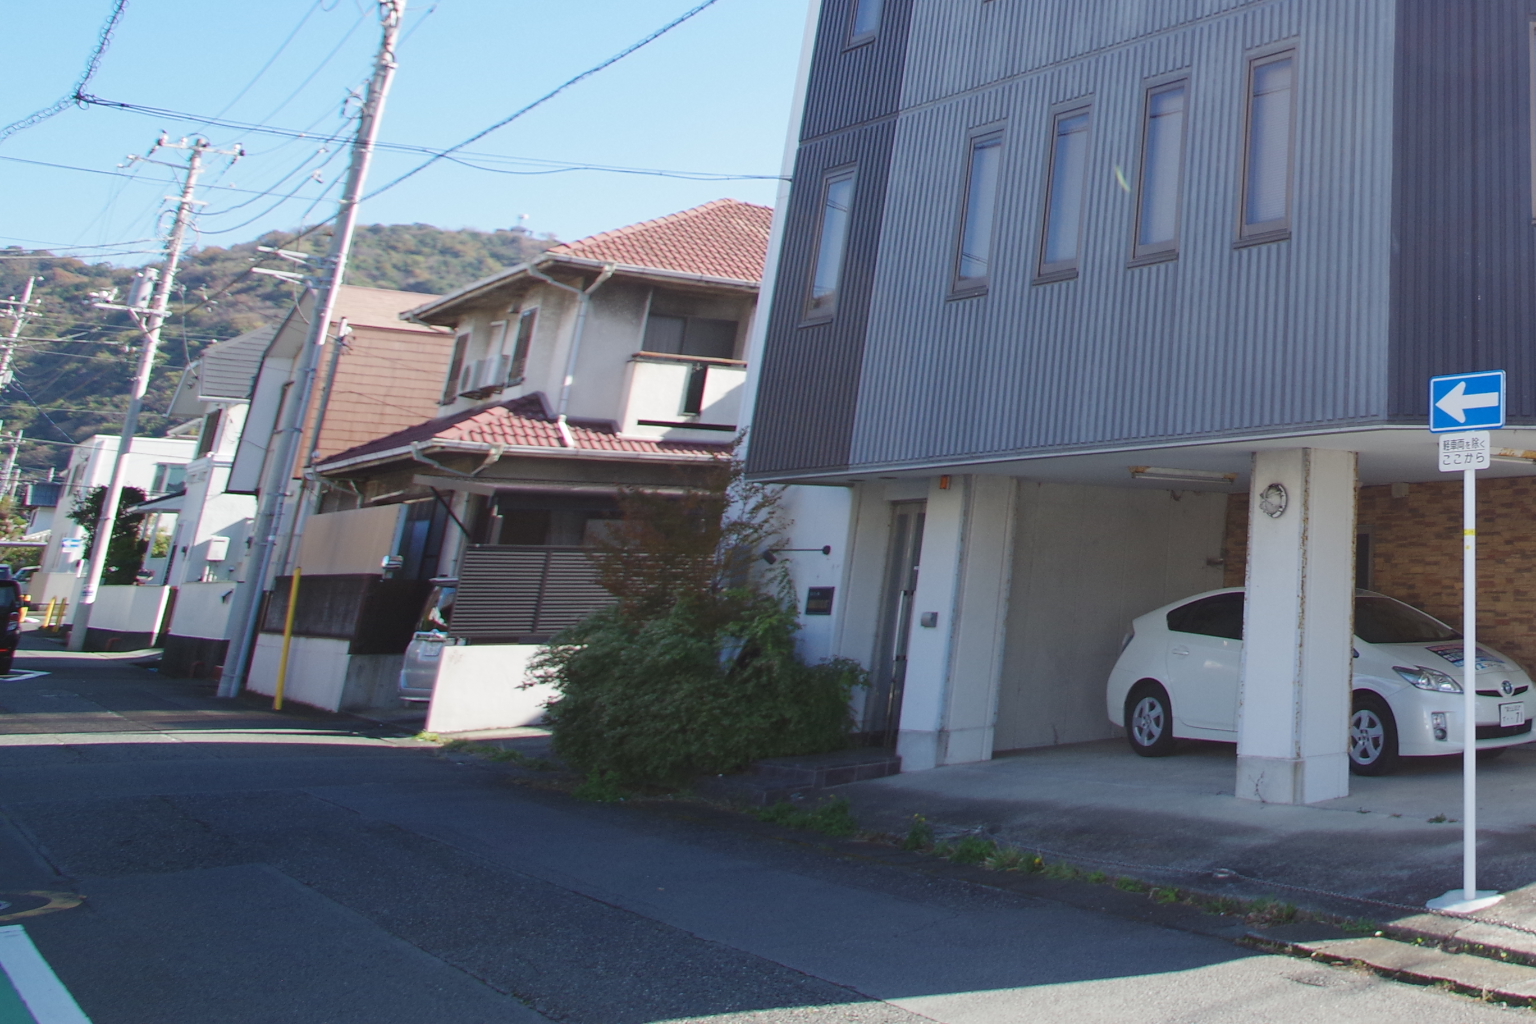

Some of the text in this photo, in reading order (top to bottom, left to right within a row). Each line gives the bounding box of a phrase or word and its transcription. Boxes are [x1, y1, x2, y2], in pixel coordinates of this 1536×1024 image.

[1442, 437, 1485, 451] 軽車両を除く
[1442, 452, 1485, 466] ここから
